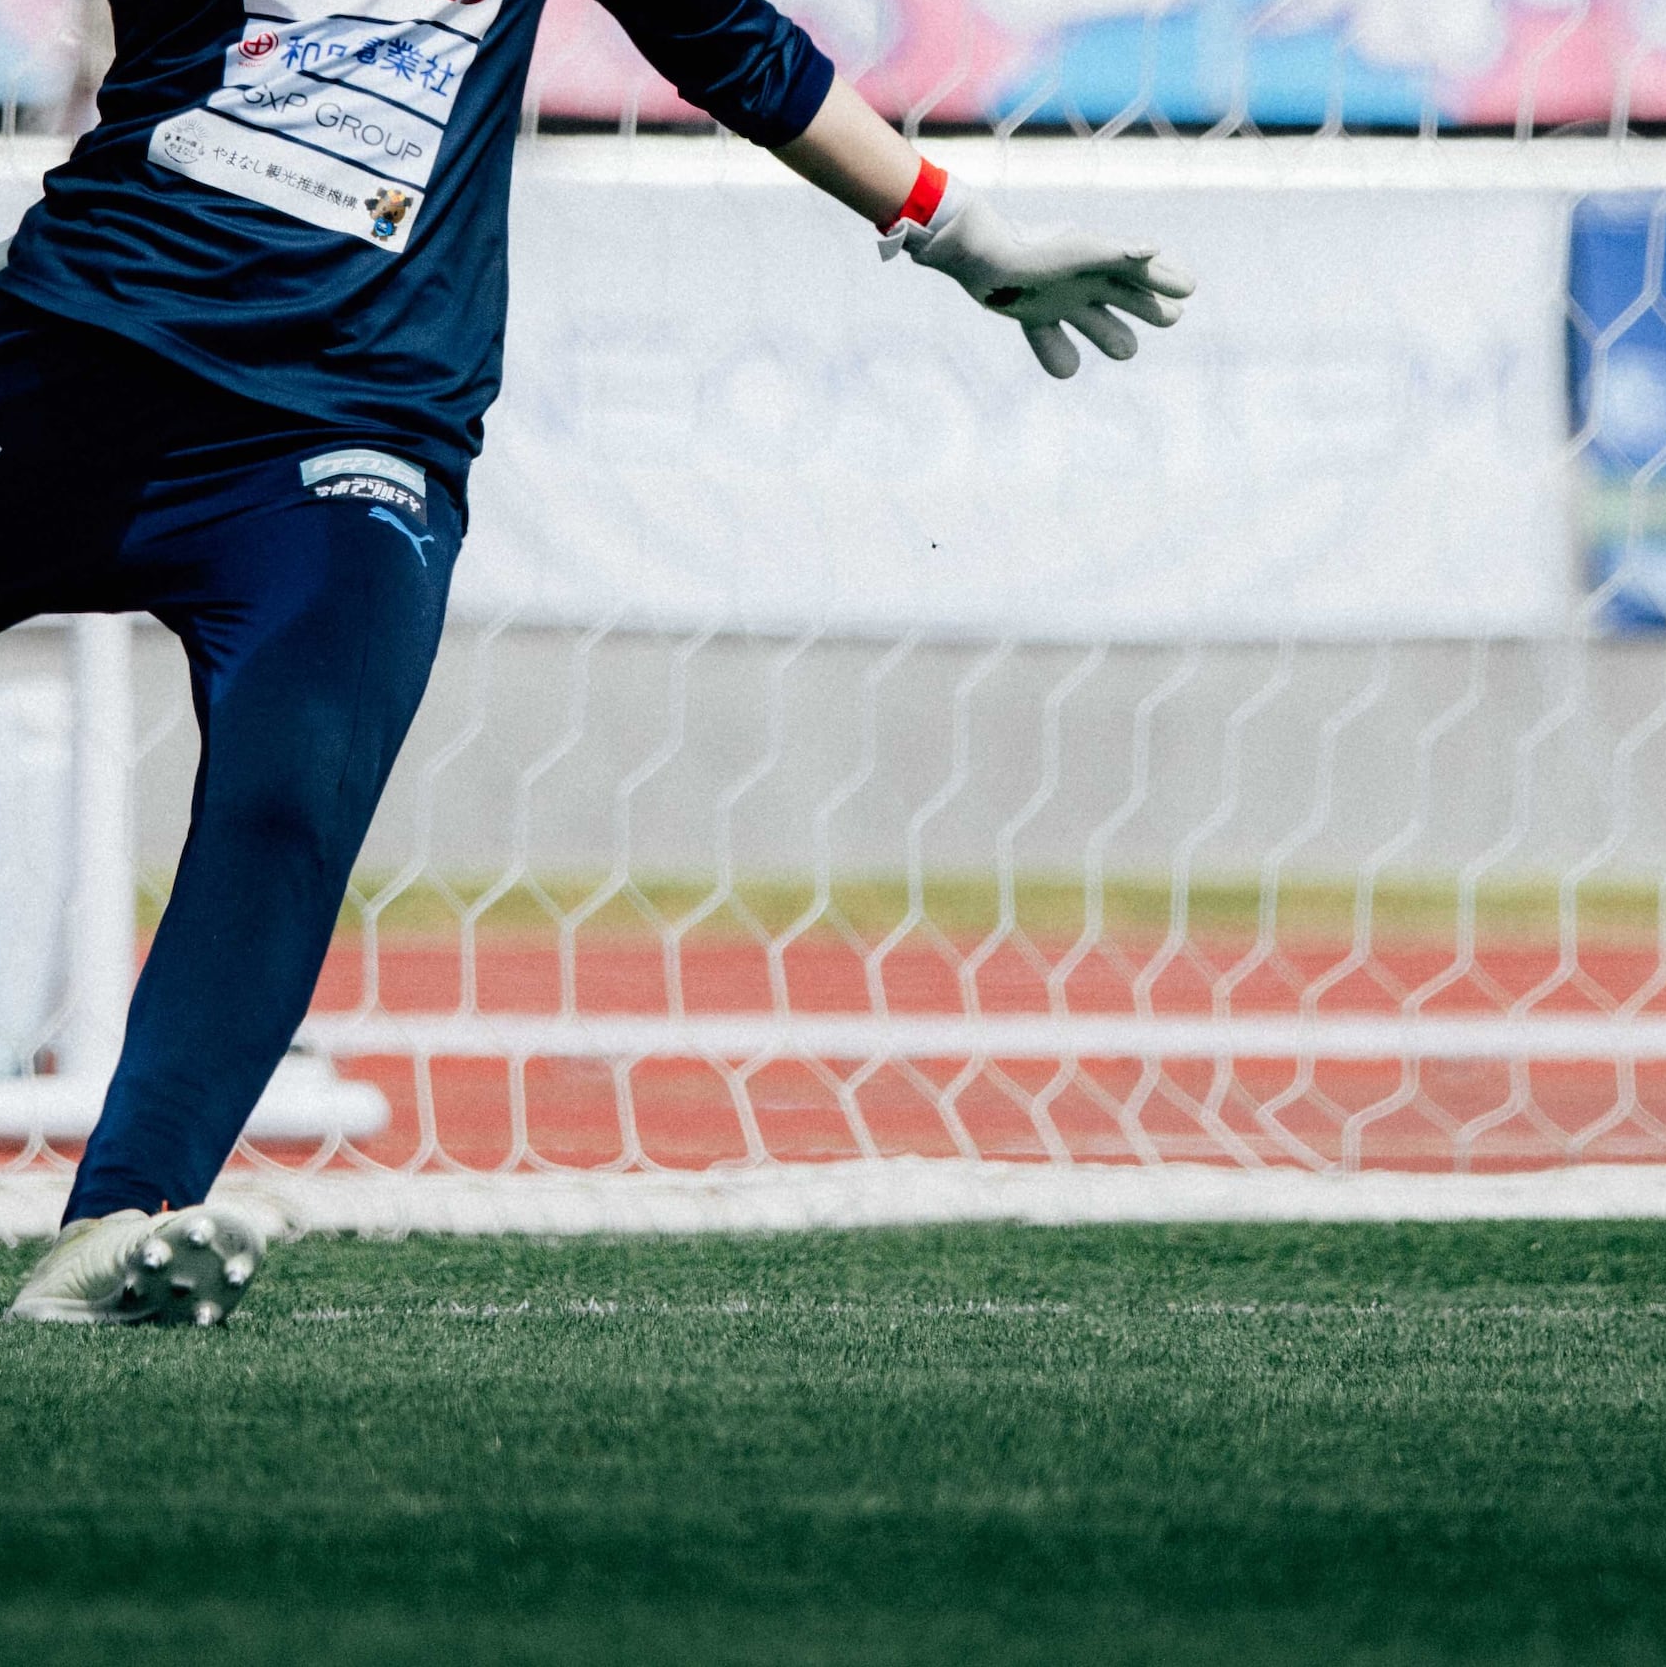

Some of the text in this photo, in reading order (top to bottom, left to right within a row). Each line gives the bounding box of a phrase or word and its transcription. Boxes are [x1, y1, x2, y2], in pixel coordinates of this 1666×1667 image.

[315, 102, 423, 161] GROUP
[213, 146, 358, 211] やまなし観光推進機構
